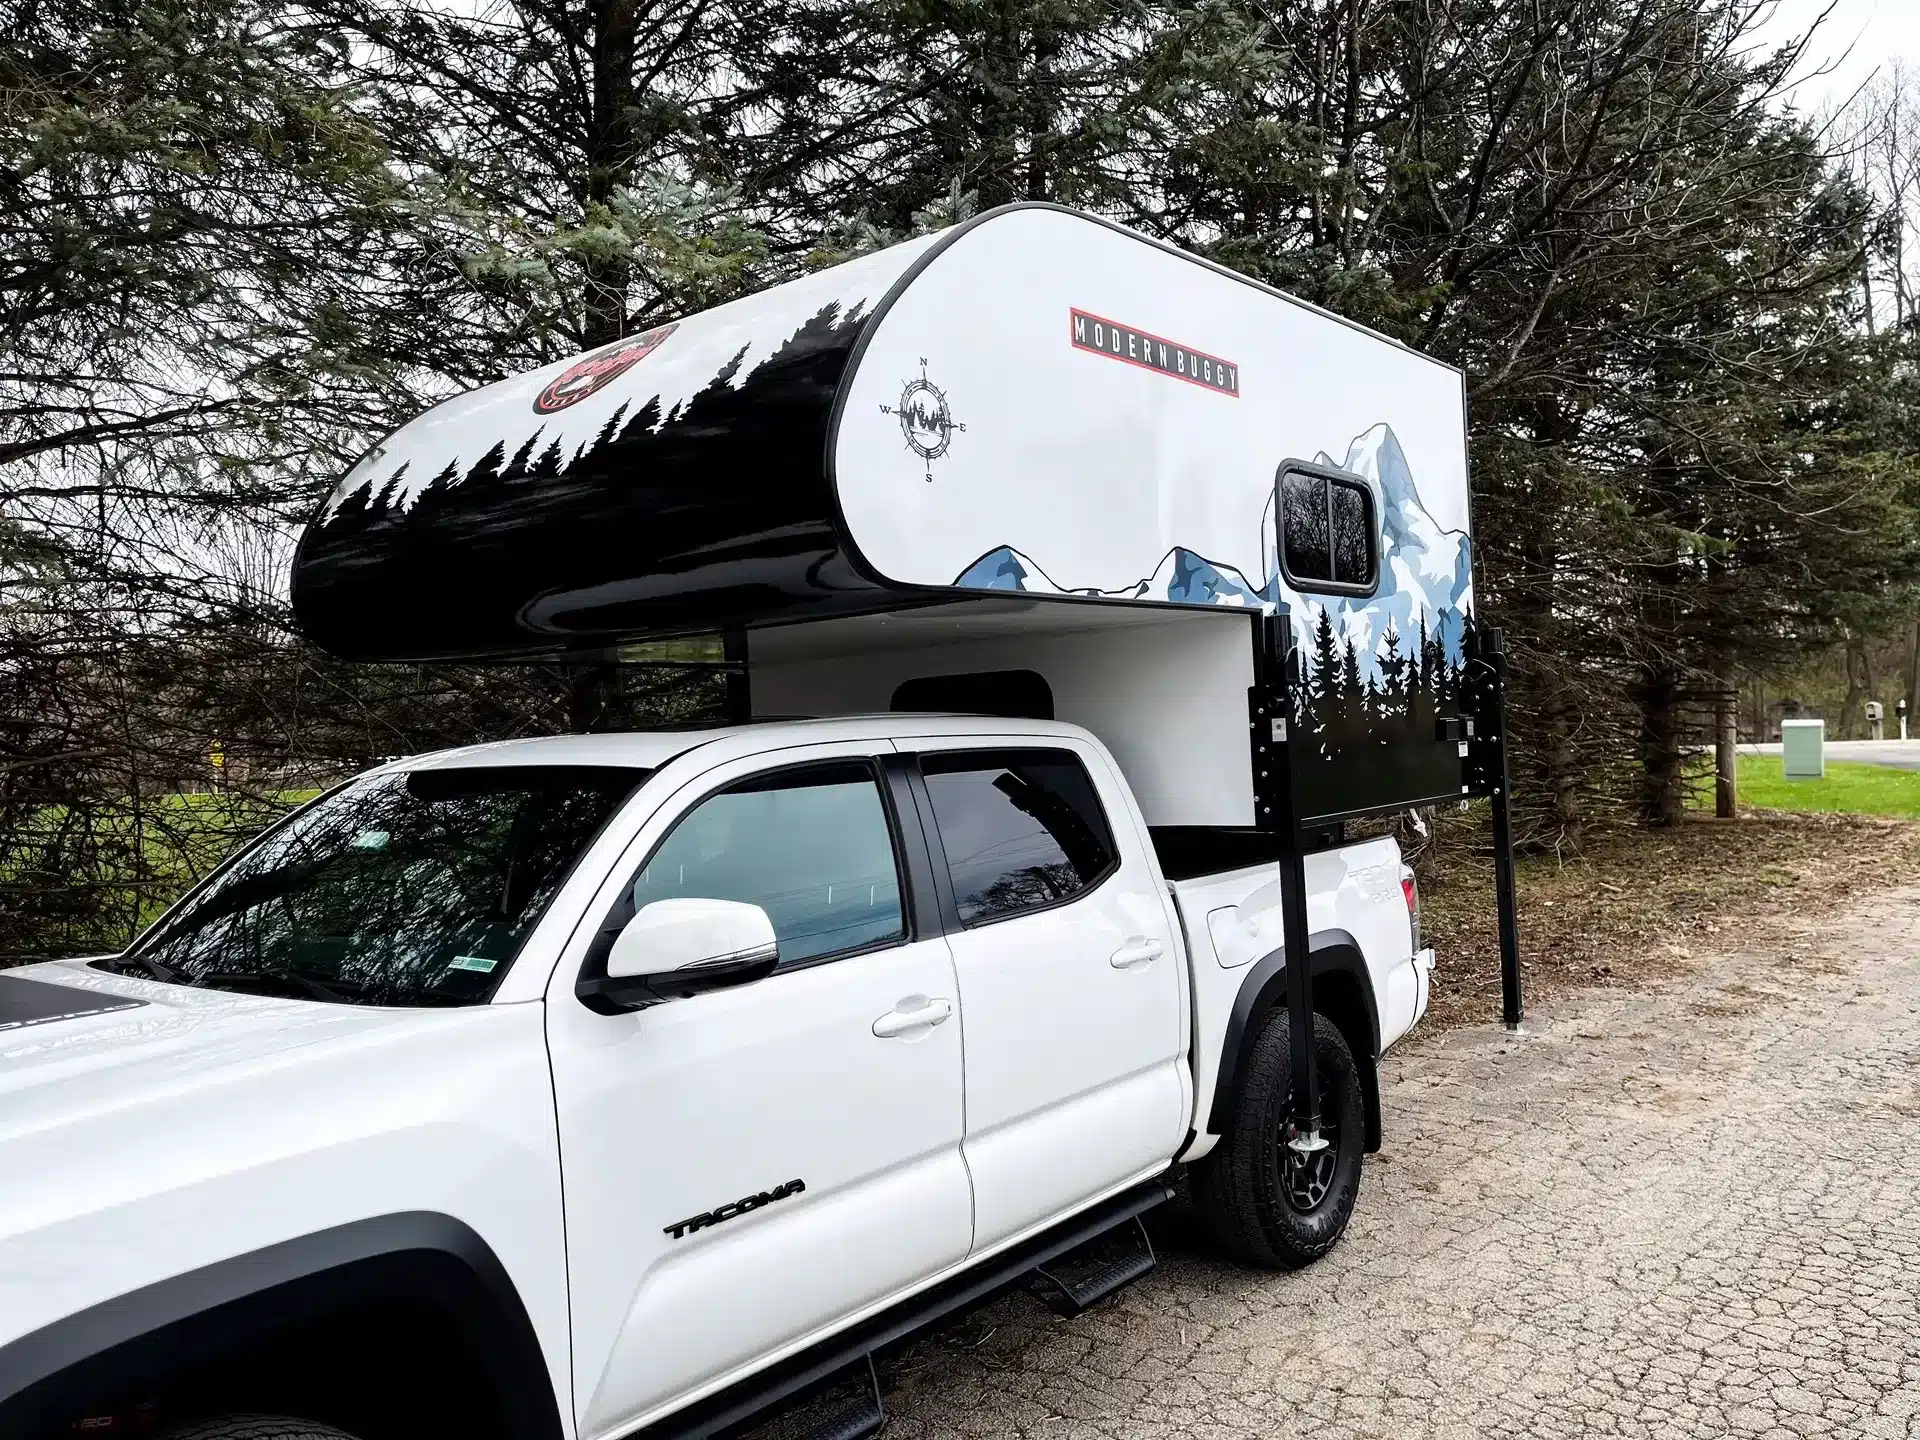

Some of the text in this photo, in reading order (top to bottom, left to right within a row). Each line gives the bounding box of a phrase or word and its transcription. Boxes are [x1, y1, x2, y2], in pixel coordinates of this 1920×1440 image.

[1073, 315, 1237, 390] MODERN BUGGY
[919, 357, 928, 366] N
[879, 404, 892, 415] W
[959, 422, 967, 433] E
[925, 473, 933, 483] S
[662, 1178, 806, 1240] TACOMA
